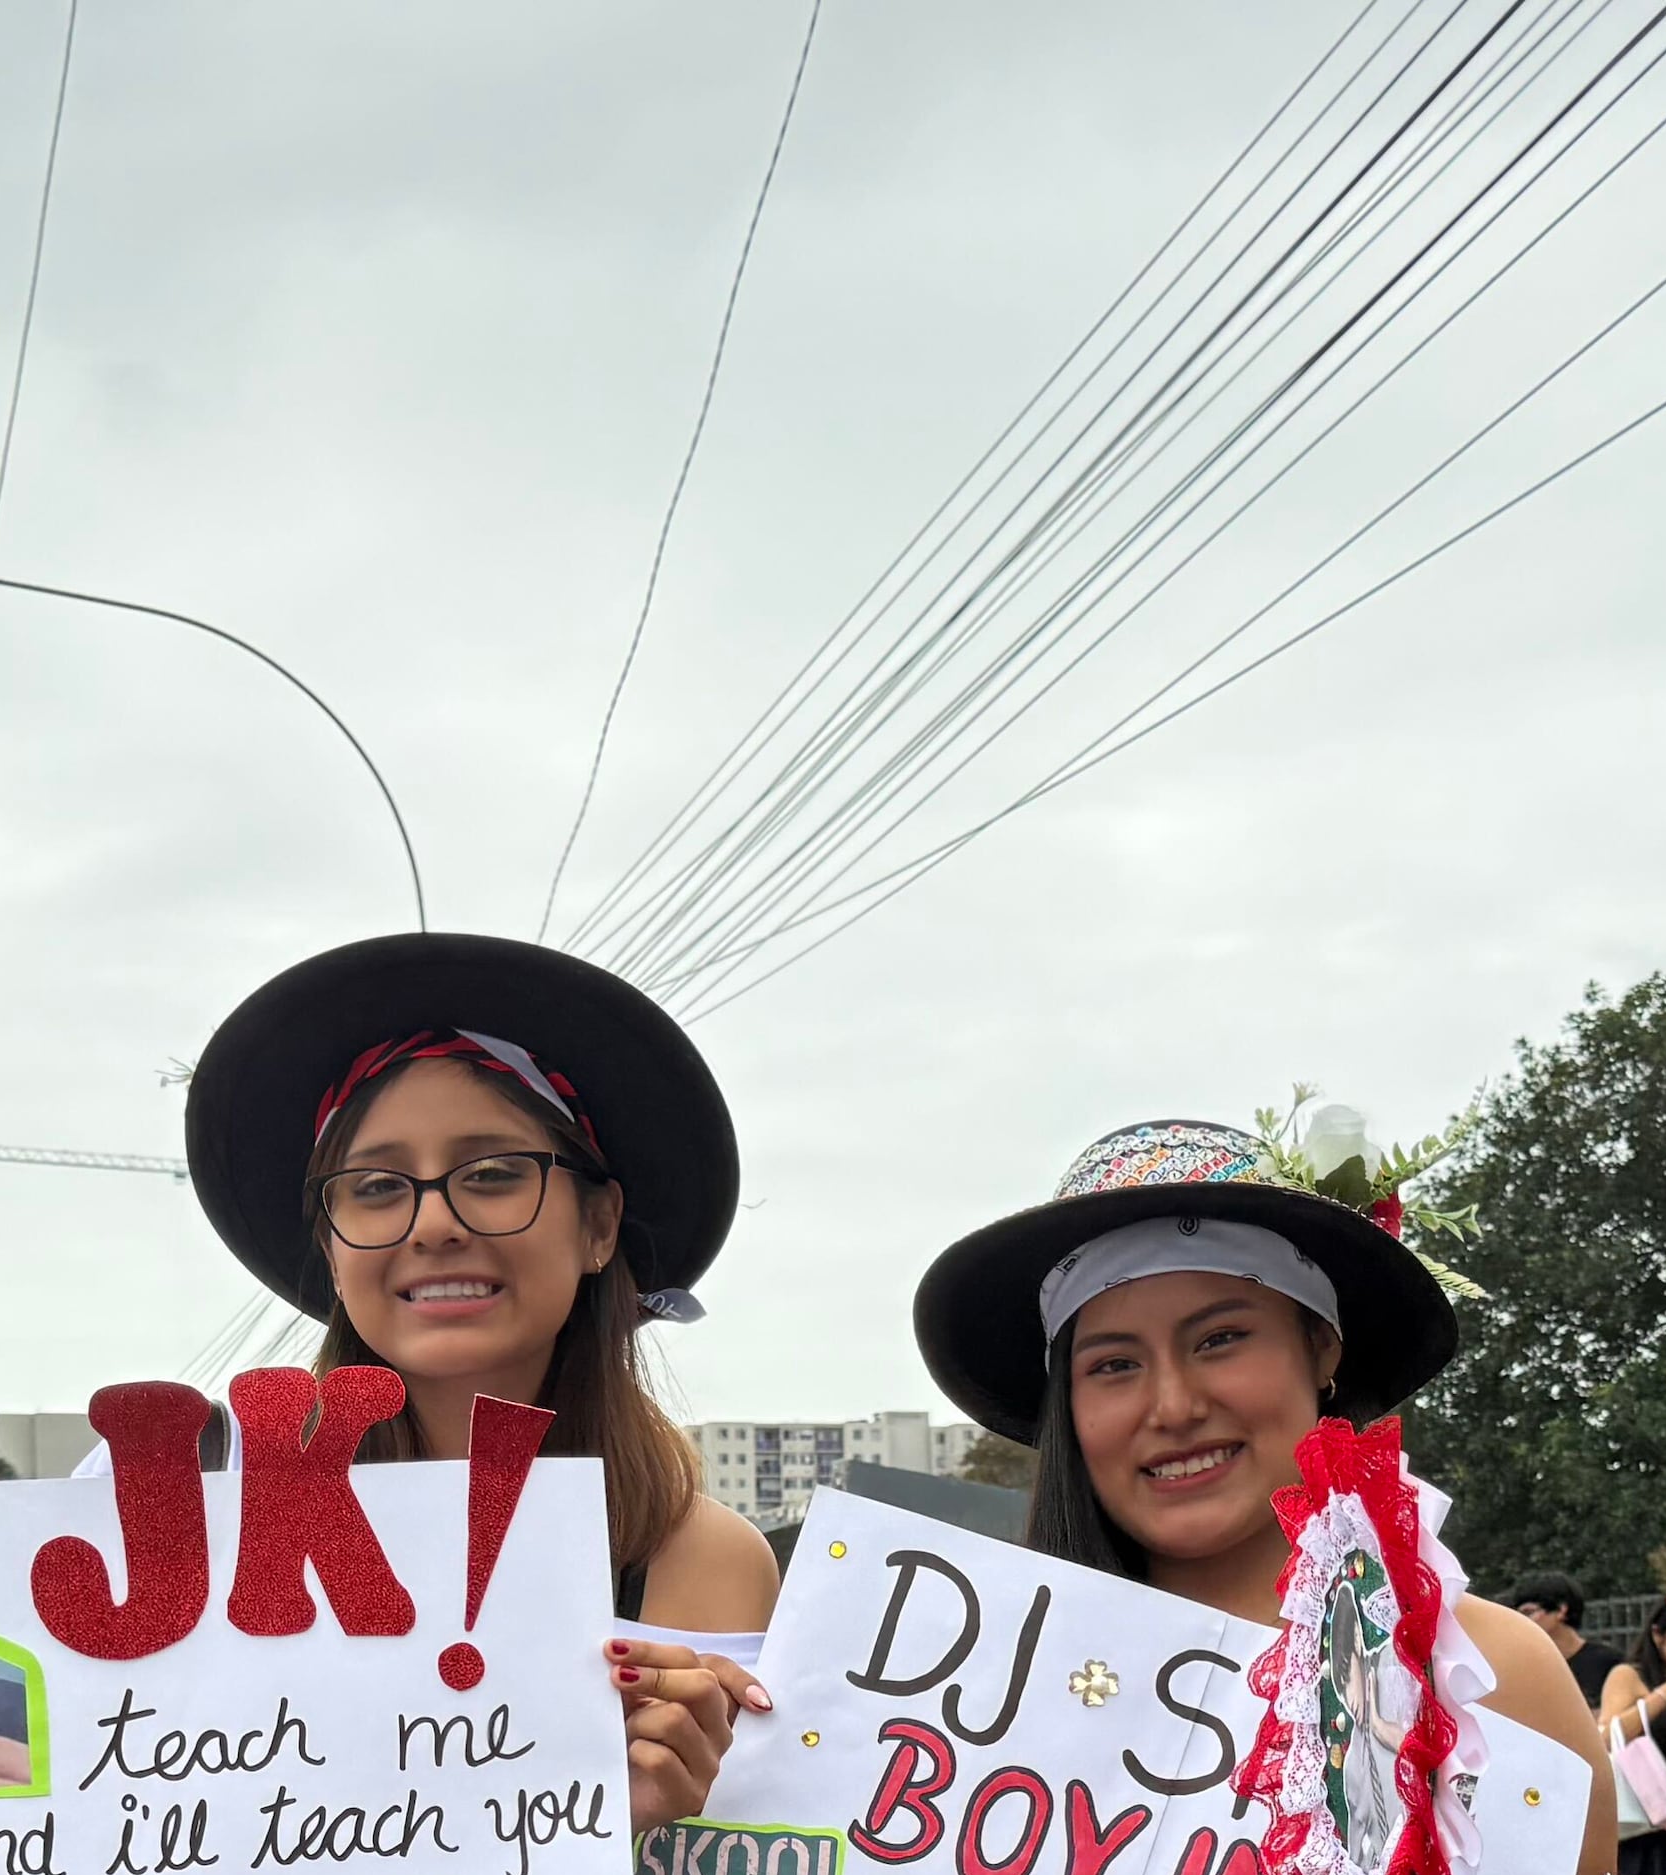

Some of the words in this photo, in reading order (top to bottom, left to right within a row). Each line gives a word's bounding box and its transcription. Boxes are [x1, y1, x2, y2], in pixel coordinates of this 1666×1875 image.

[30, 1364, 556, 1691] JK!
[847, 1549, 1051, 1747] DJ
[79, 1688, 326, 1791] teach
[397, 1702, 536, 1769] me
[251, 1789, 458, 1869] teach
